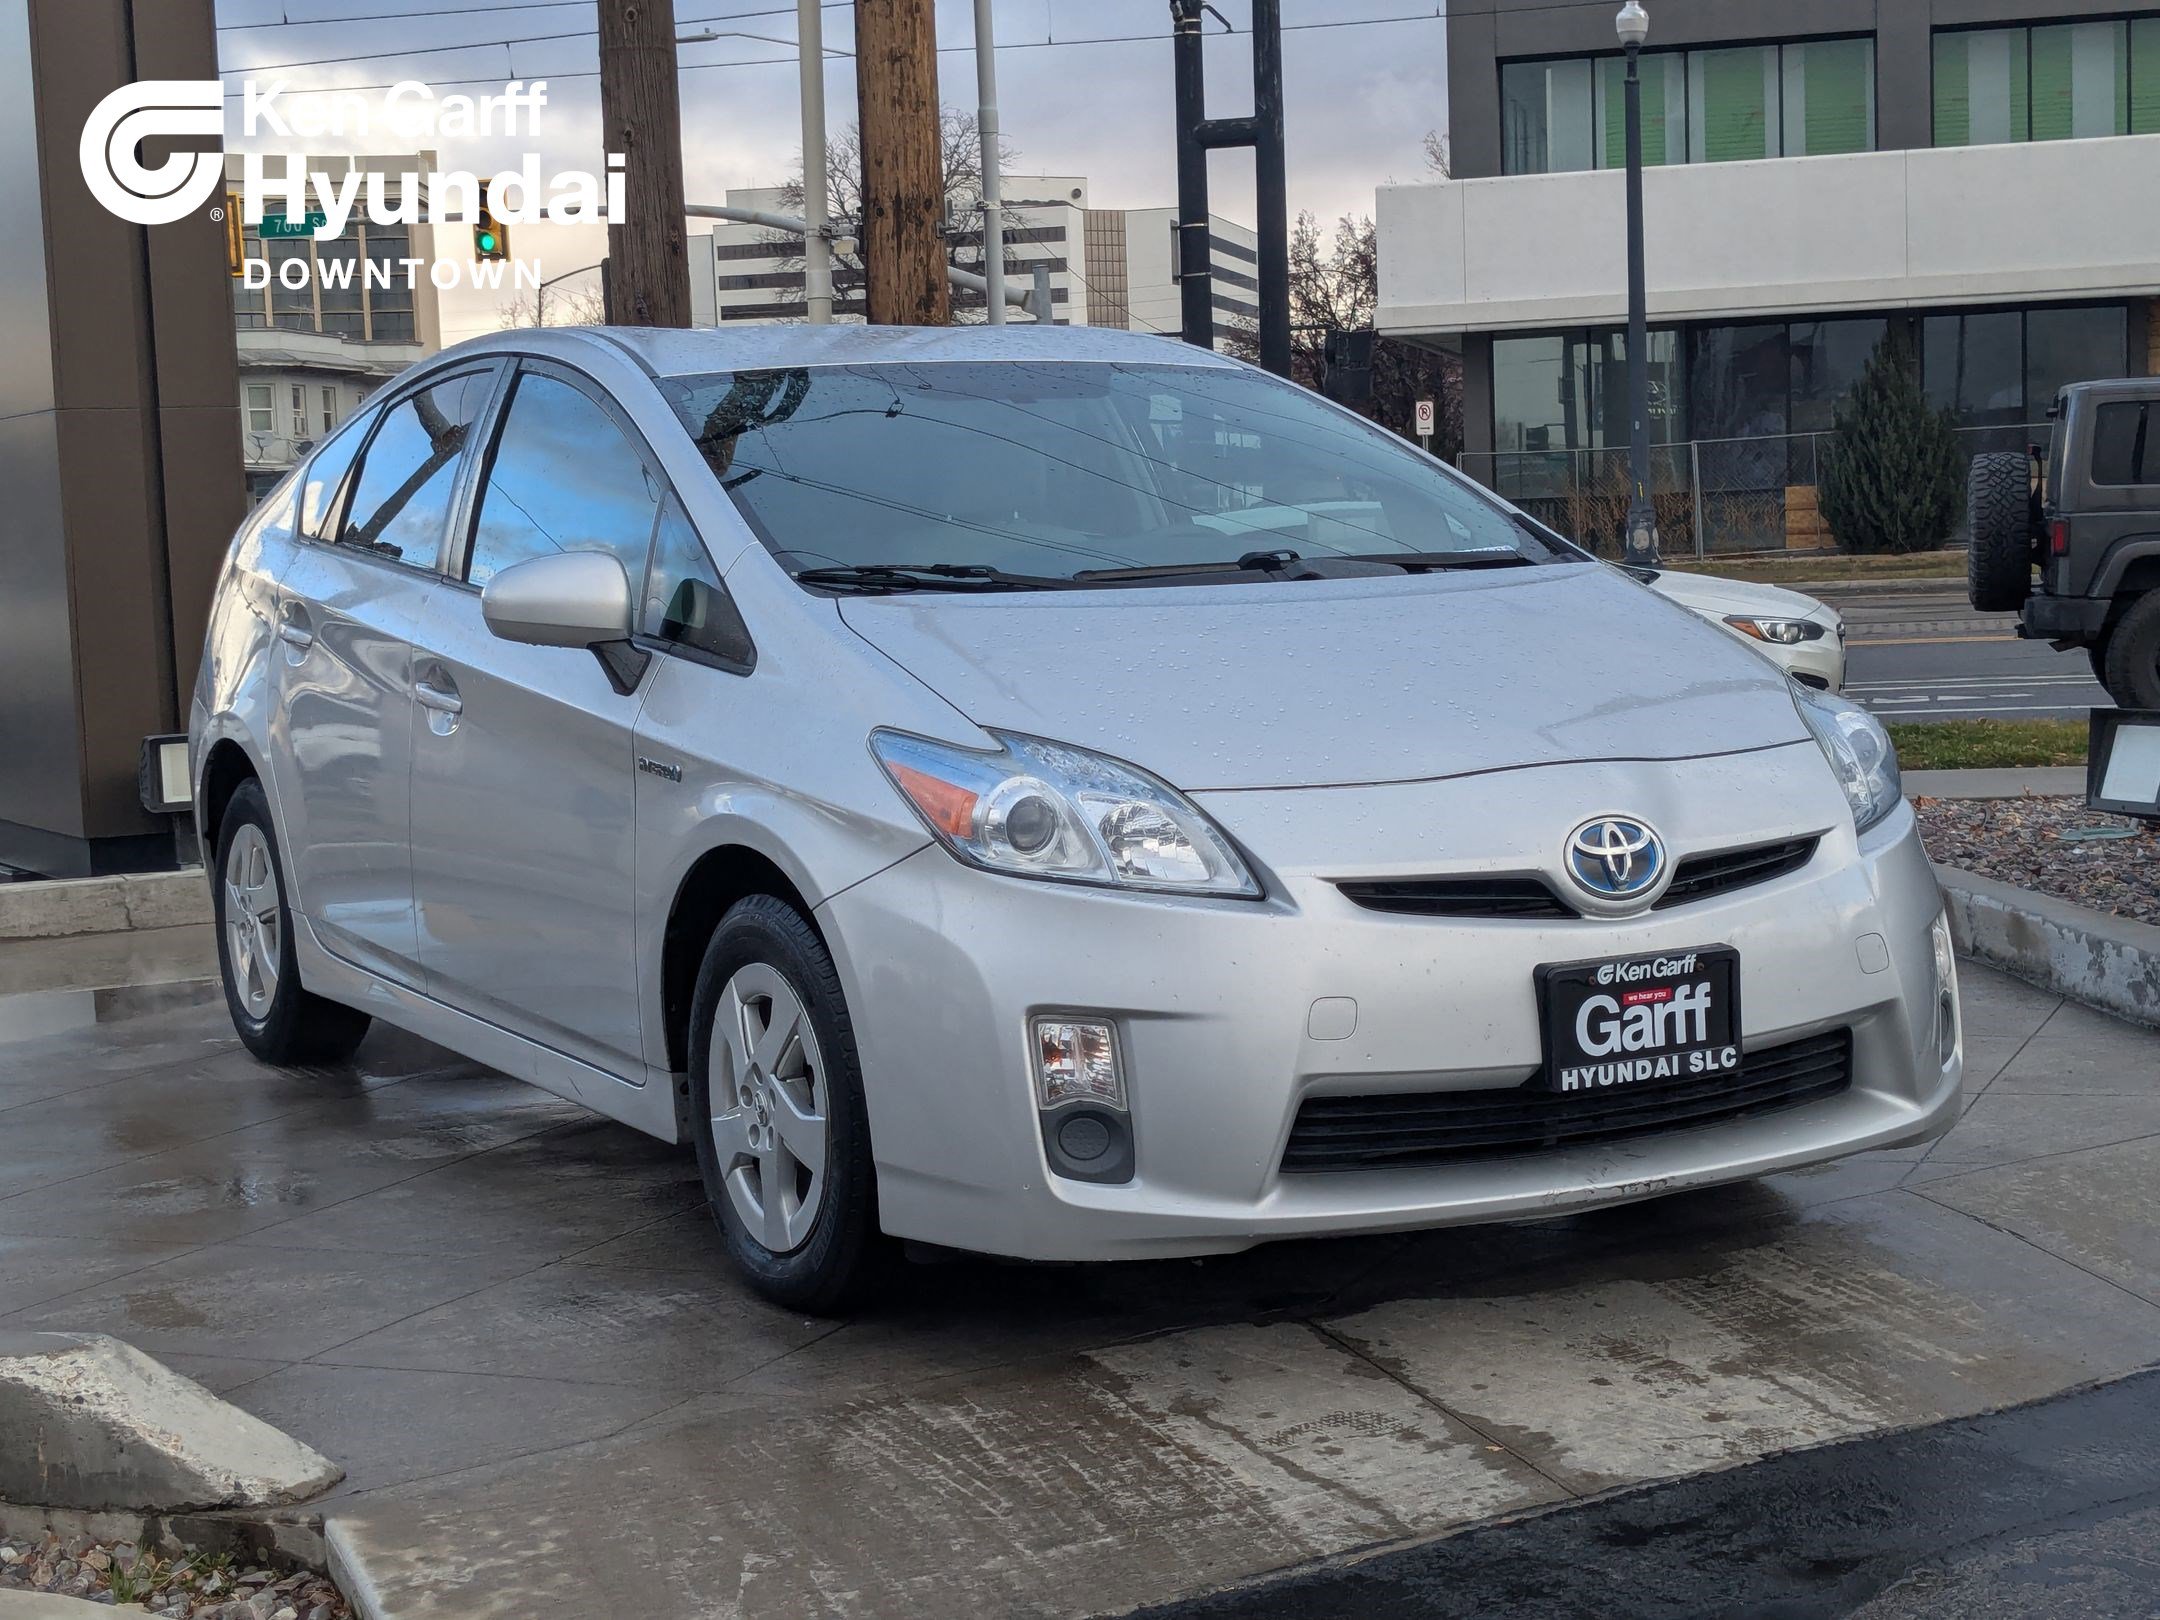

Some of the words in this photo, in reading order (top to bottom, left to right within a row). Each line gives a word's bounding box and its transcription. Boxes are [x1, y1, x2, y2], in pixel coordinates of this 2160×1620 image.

[274, 217, 302, 233] 700
[1615, 961, 1651, 983] Ken
[1652, 954, 1697, 978] Garff
[1638, 992, 1653, 1000] hear
[1654, 991, 1667, 1000] you
[1575, 982, 1711, 1057] Garff
[1561, 1055, 1679, 1091] HYUNDAI
[1689, 1047, 1737, 1073] SLC
